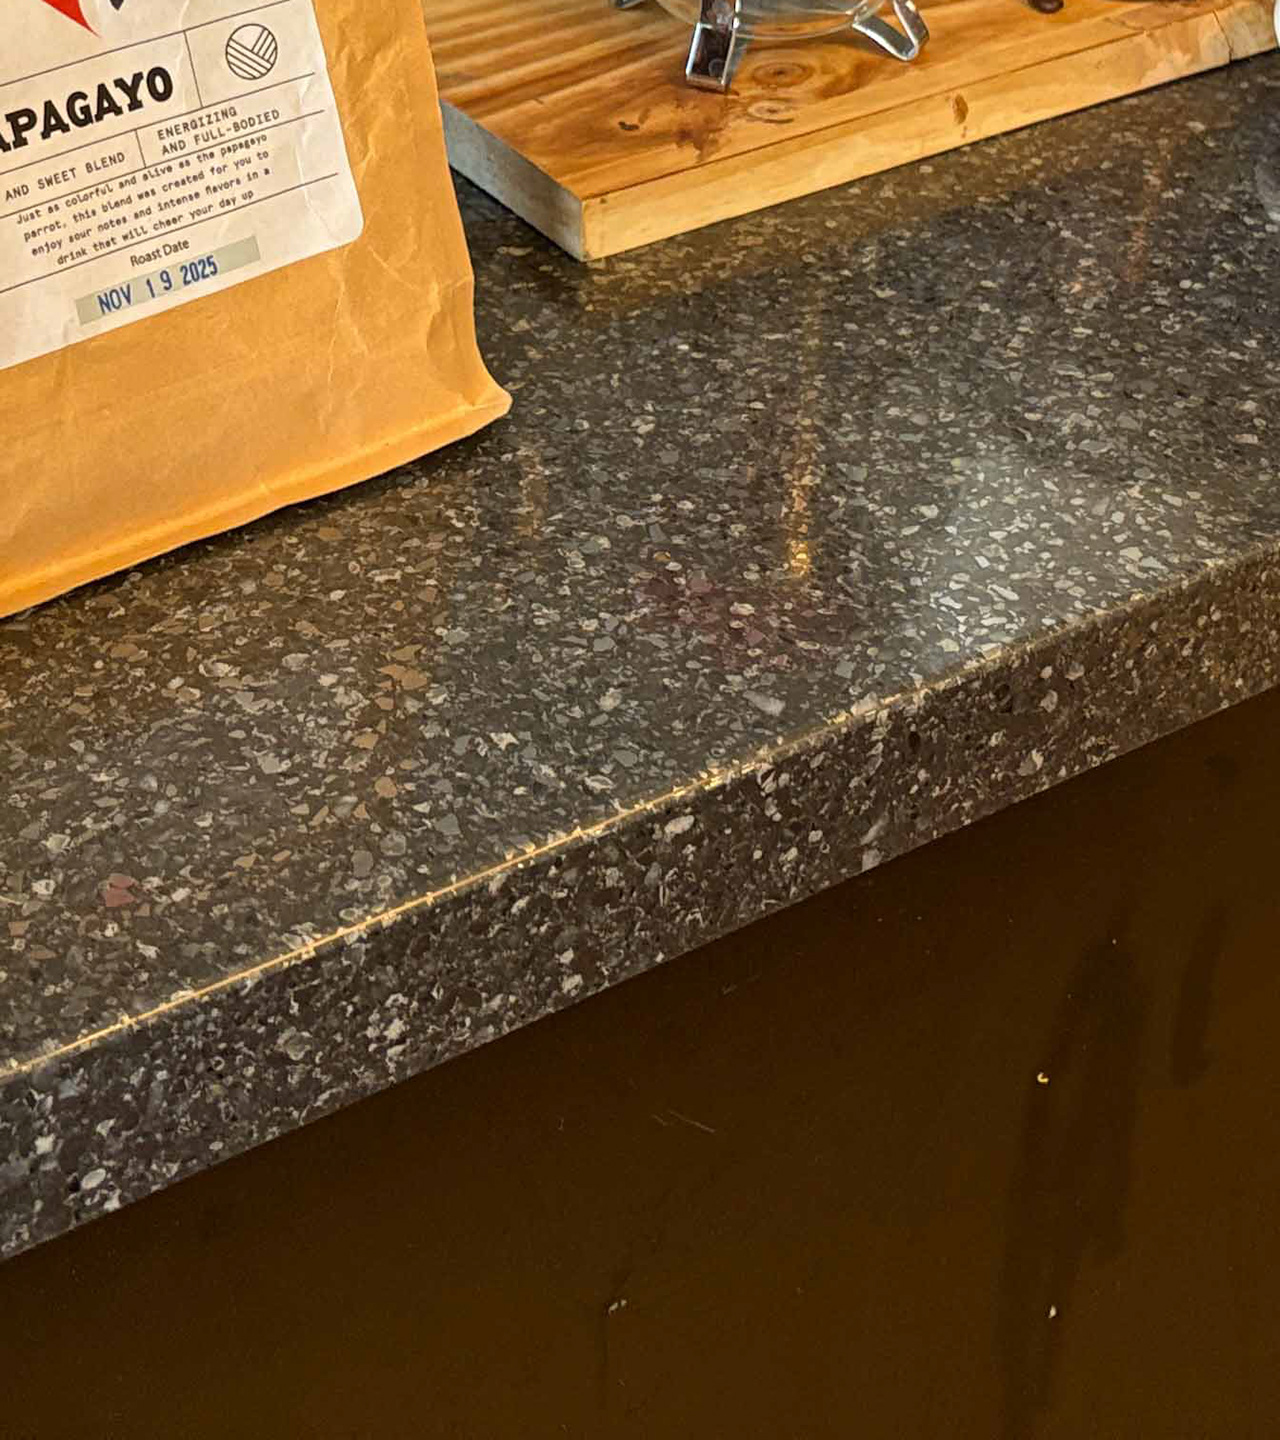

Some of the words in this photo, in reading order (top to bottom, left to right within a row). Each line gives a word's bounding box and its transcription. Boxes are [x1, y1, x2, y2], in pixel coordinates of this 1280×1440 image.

[157, 106, 238, 140] ENERGIZING
[161, 140, 187, 156] AND
[193, 109, 280, 146] FULL-BODIED
[5, 184, 30, 202] AND
[37, 167, 78, 190] SWEET
[85, 152, 126, 174] BLEND
[17, 209, 42, 225] Just
[48, 203, 60, 215] as
[65, 183, 114, 208] colorful
[120, 176, 137, 190] and
[142, 165, 173, 182] alive
[178, 160, 191, 169] as
[196, 151, 215, 164] the
[220, 134, 268, 157] papagayo
[23, 220, 67, 243] parrot,
[72, 208, 97, 224] this
[101, 195, 133, 213] blend
[136, 188, 157, 201] was
[161, 171, 205, 193] created
[210, 163, 228, 177] for
[233, 158, 252, 170] you
[257, 150, 269, 161] to
[31, 239, 63, 257] enjoy
[69, 227, 92, 243] sour
[97, 215, 128, 233] notes
[133, 205, 153, 220] and
[157, 190, 201, 212] intense
[205, 177, 241, 195] flavors
[246, 171, 259, 182] in
[264, 167, 271, 176] a
[56, 248, 88, 265] drink
[92, 236, 118, 252] that
[122, 226, 149, 242] will
[152, 215, 183, 232] cheer
[189, 203, 215, 221] your
[219, 197, 237, 210] day
[241, 190, 254, 201] up
[130, 247, 163, 268] Roast
[163, 239, 190, 258] Date
[97, 283, 133, 315] NOV
[179, 255, 219, 287] 2025
